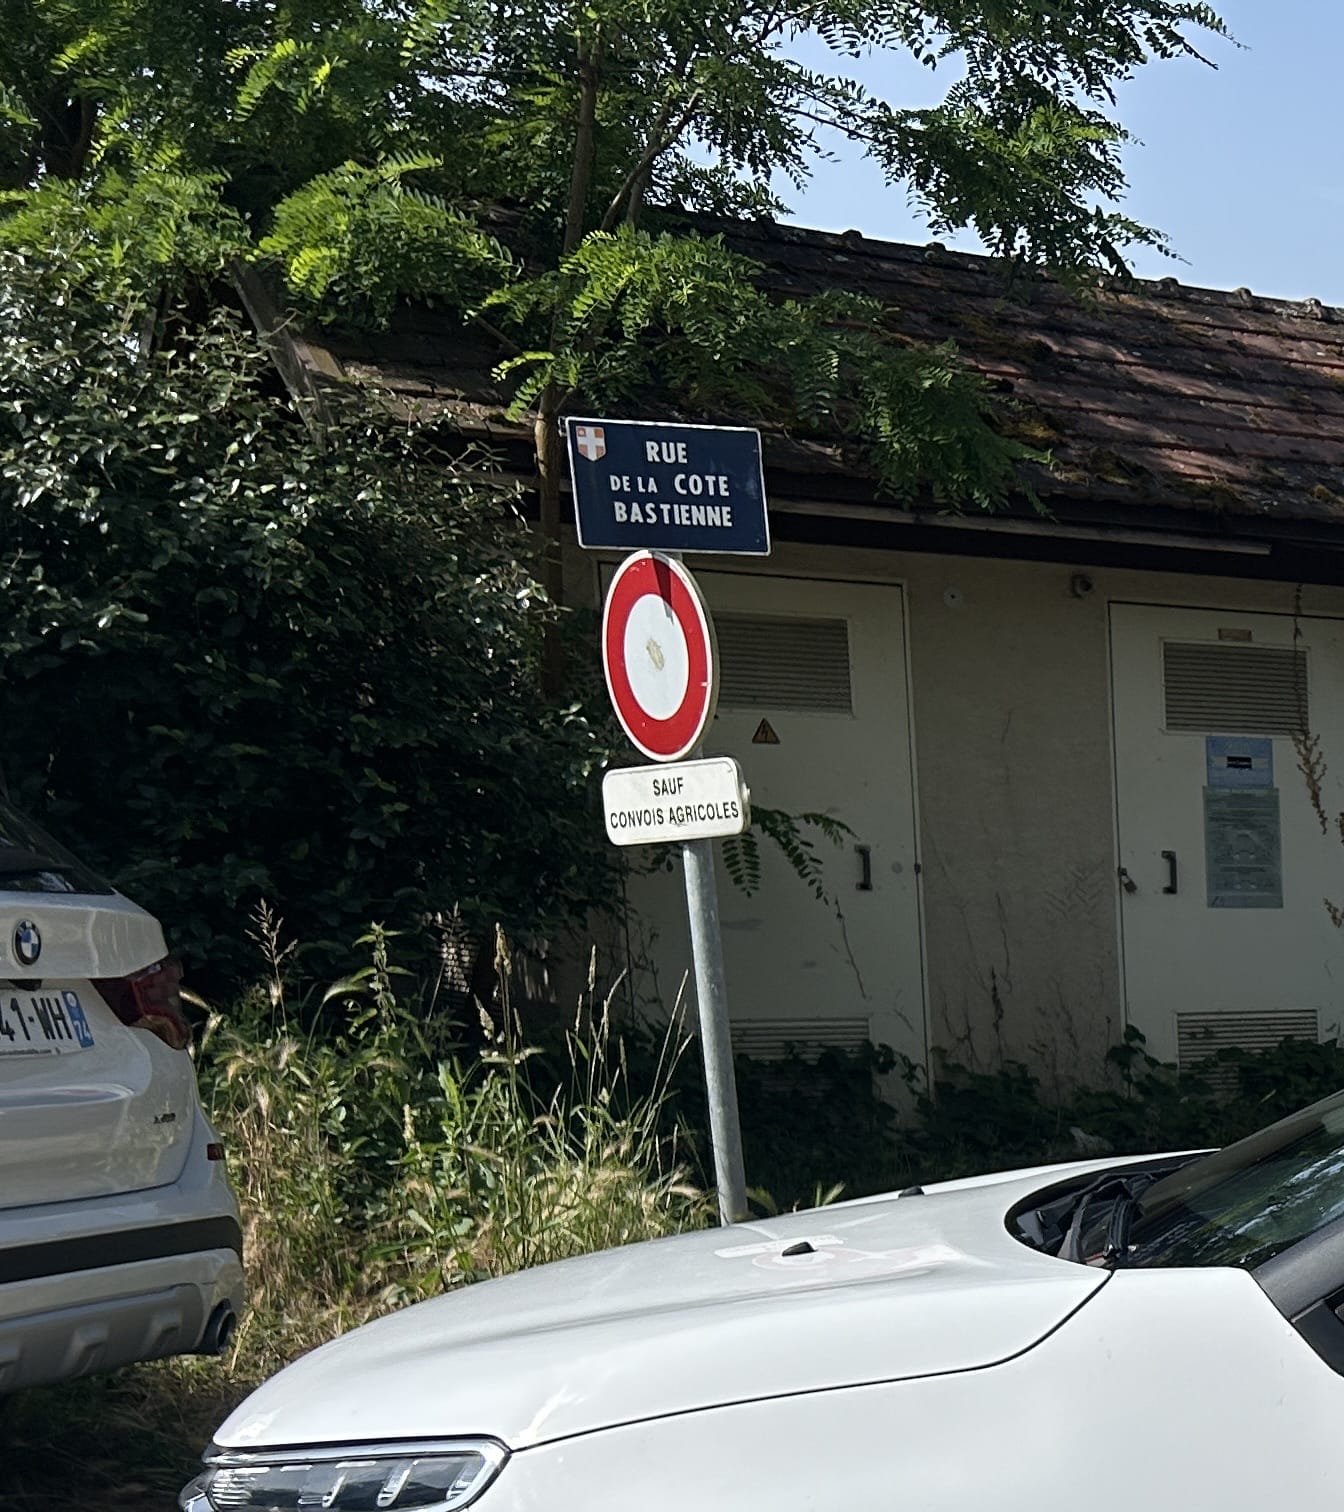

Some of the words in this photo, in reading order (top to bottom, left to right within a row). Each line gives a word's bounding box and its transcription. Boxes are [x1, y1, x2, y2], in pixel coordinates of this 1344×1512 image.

[645, 440, 688, 464] RUE
[609, 474, 631, 492] DE
[637, 476, 658, 494] LA
[674, 473, 730, 497] COTE
[613, 500, 733, 527] BASTIENNE
[652, 776, 684, 797] SAUF
[610, 807, 664, 829] CONVOIS
[669, 801, 739, 824] AGRICOLES
